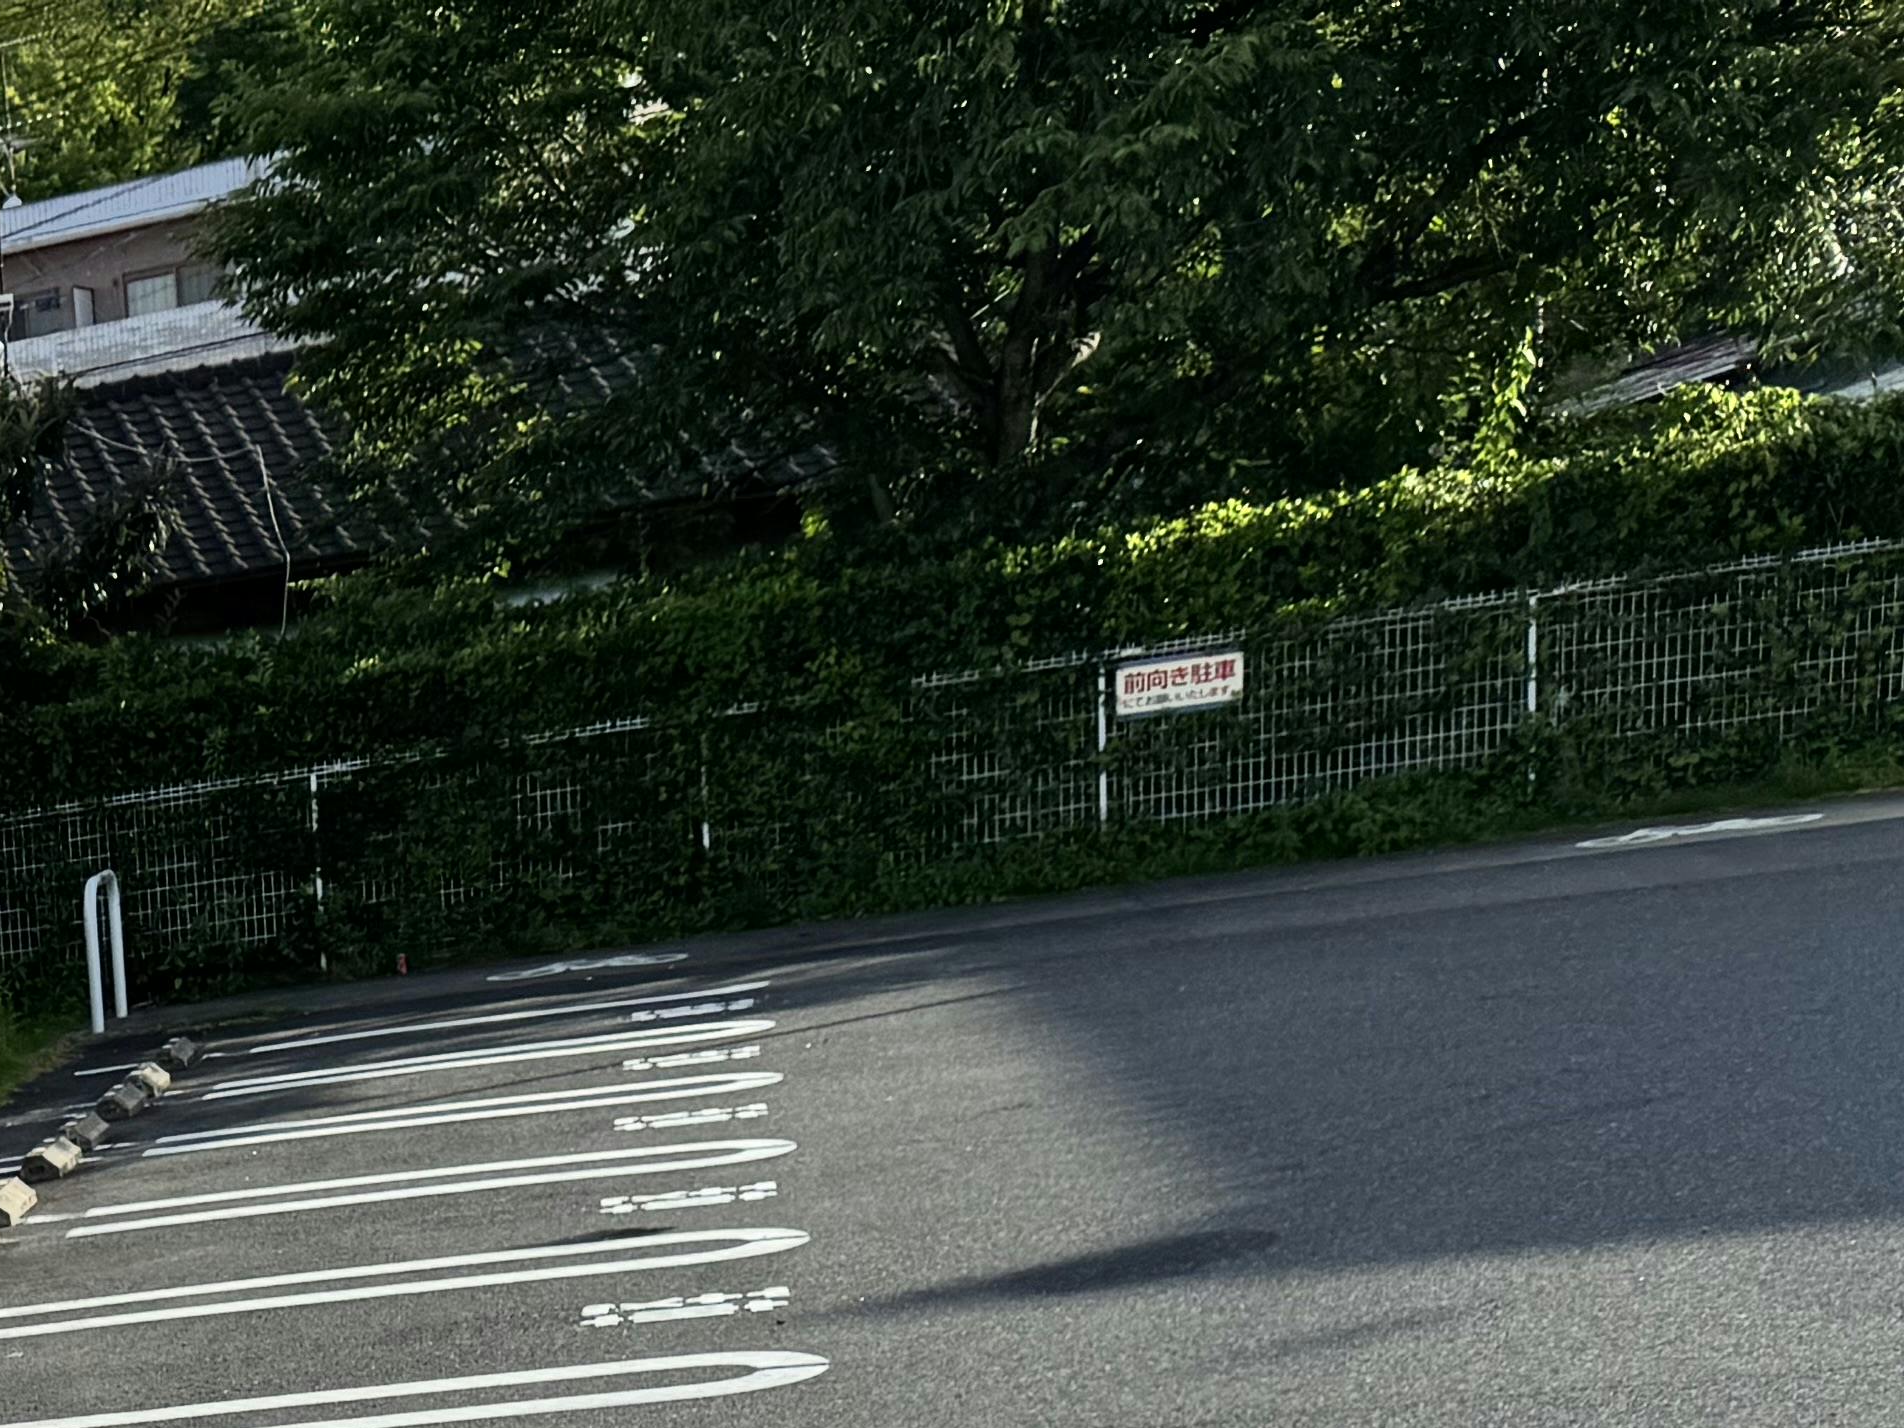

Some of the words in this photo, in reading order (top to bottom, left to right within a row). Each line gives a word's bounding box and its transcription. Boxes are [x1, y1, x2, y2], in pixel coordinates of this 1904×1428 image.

[1124, 659, 1236, 695] 前向き駐車
